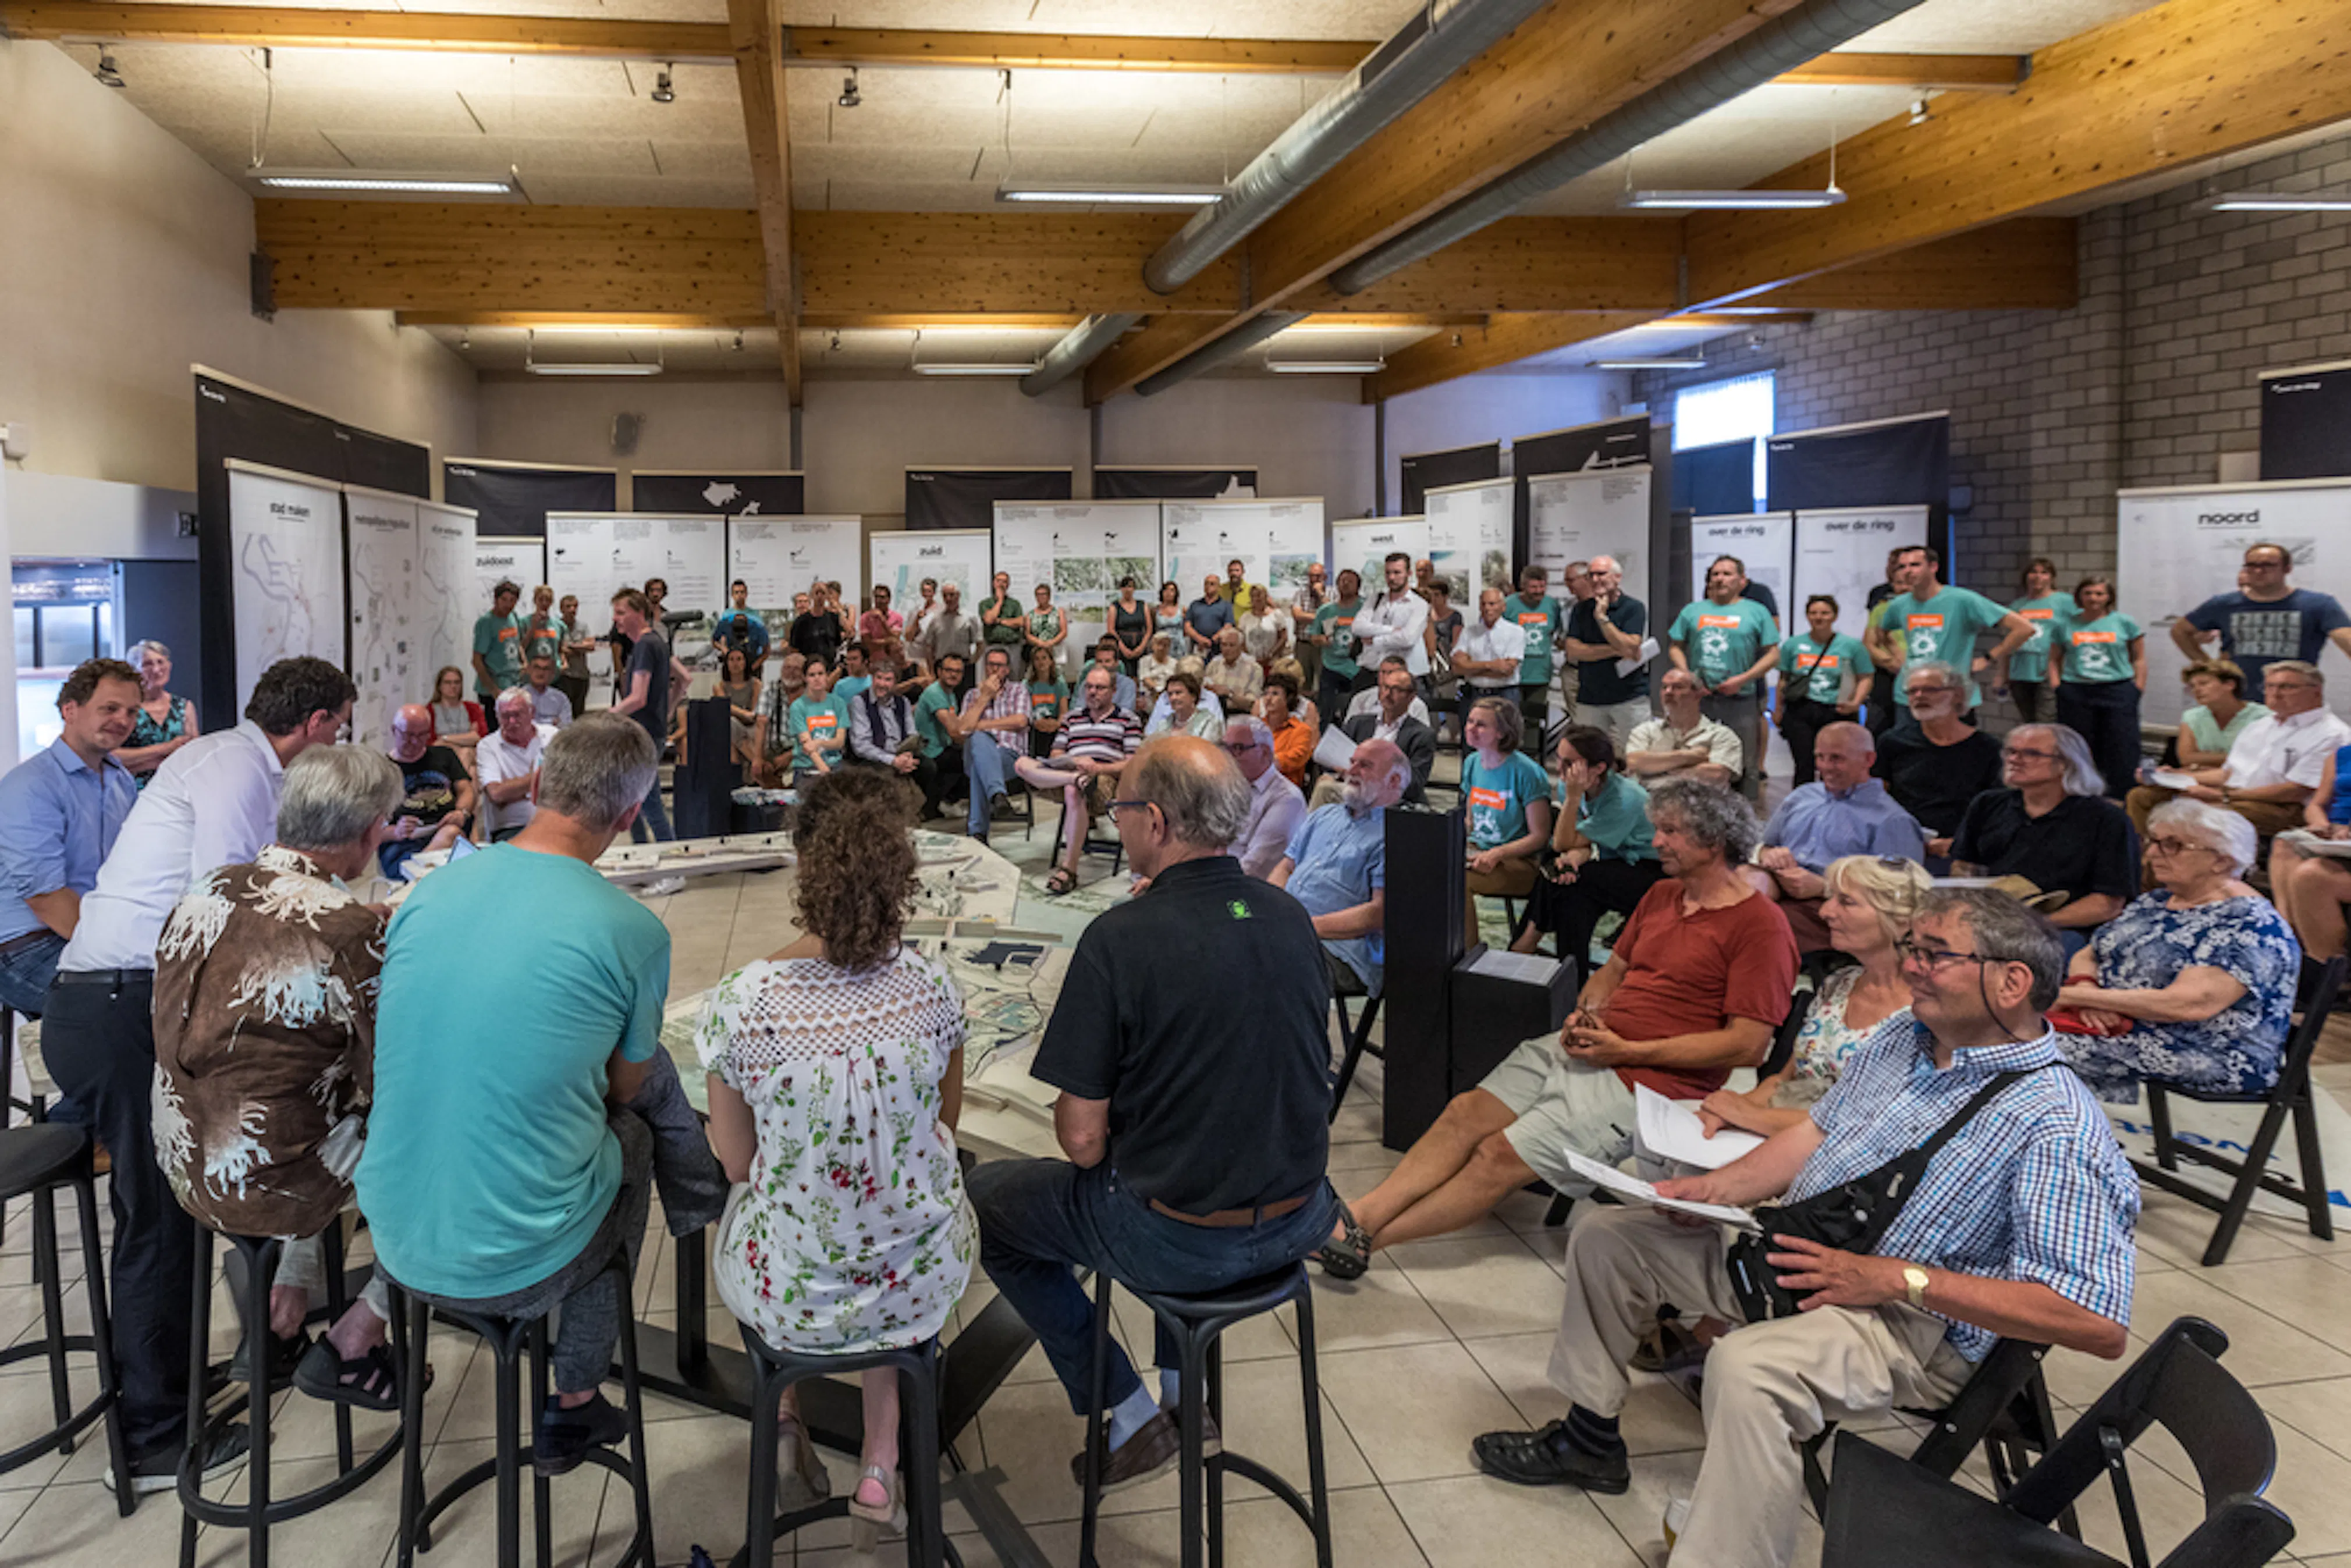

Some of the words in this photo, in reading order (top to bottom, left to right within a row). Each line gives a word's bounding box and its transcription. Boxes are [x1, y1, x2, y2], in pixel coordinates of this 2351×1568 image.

[2198, 509, 2260, 524] noord
[1708, 527, 1728, 536] over
[1731, 525, 1742, 535] de
[1745, 524, 1765, 537] ring
[1824, 522, 1849, 532] over
[1852, 520, 1867, 531] de
[1870, 519, 1895, 534] ring
[1370, 534, 1394, 542] west
[919, 545, 943, 556] zuid
[476, 554, 513, 567] zuidoost
